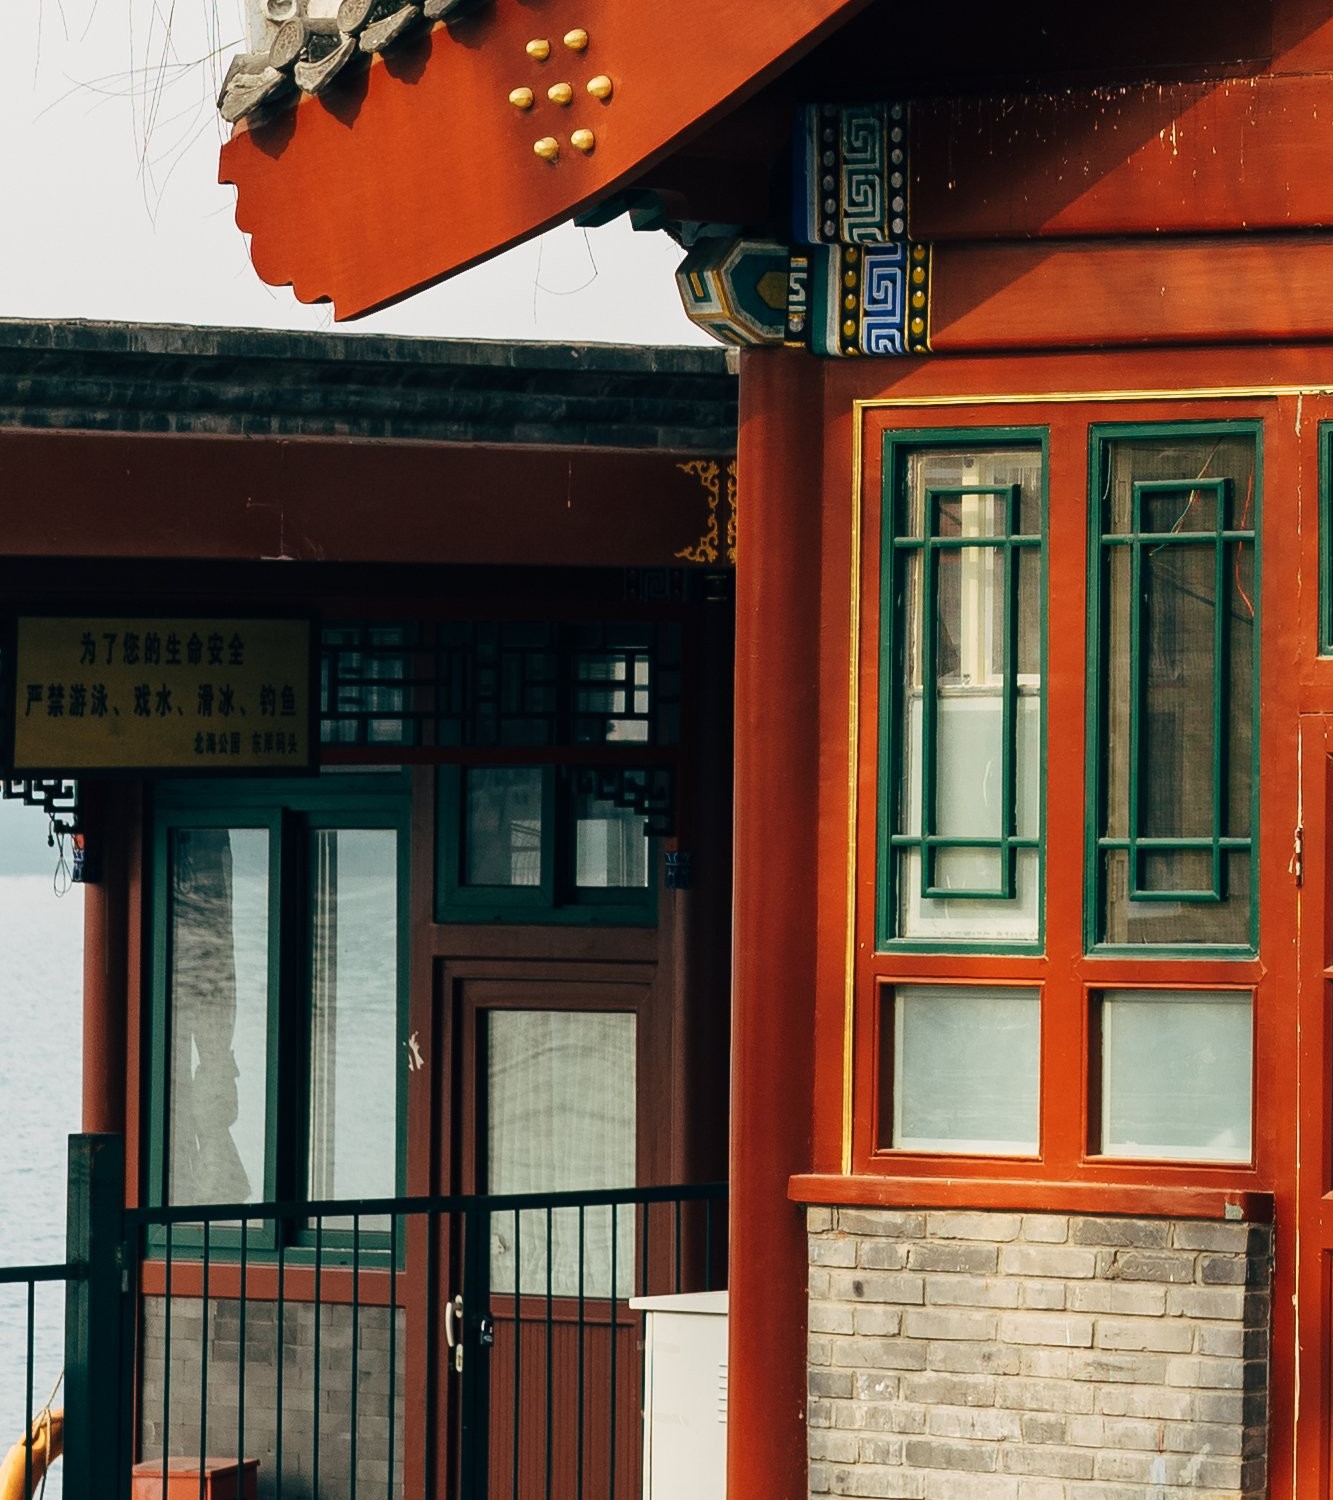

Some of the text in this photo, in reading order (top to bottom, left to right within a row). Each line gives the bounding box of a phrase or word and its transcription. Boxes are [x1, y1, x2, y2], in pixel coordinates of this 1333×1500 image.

[79, 631, 245, 665] 为了您的生命安全
[194, 731, 298, 755] 北海公园 东岸码头
